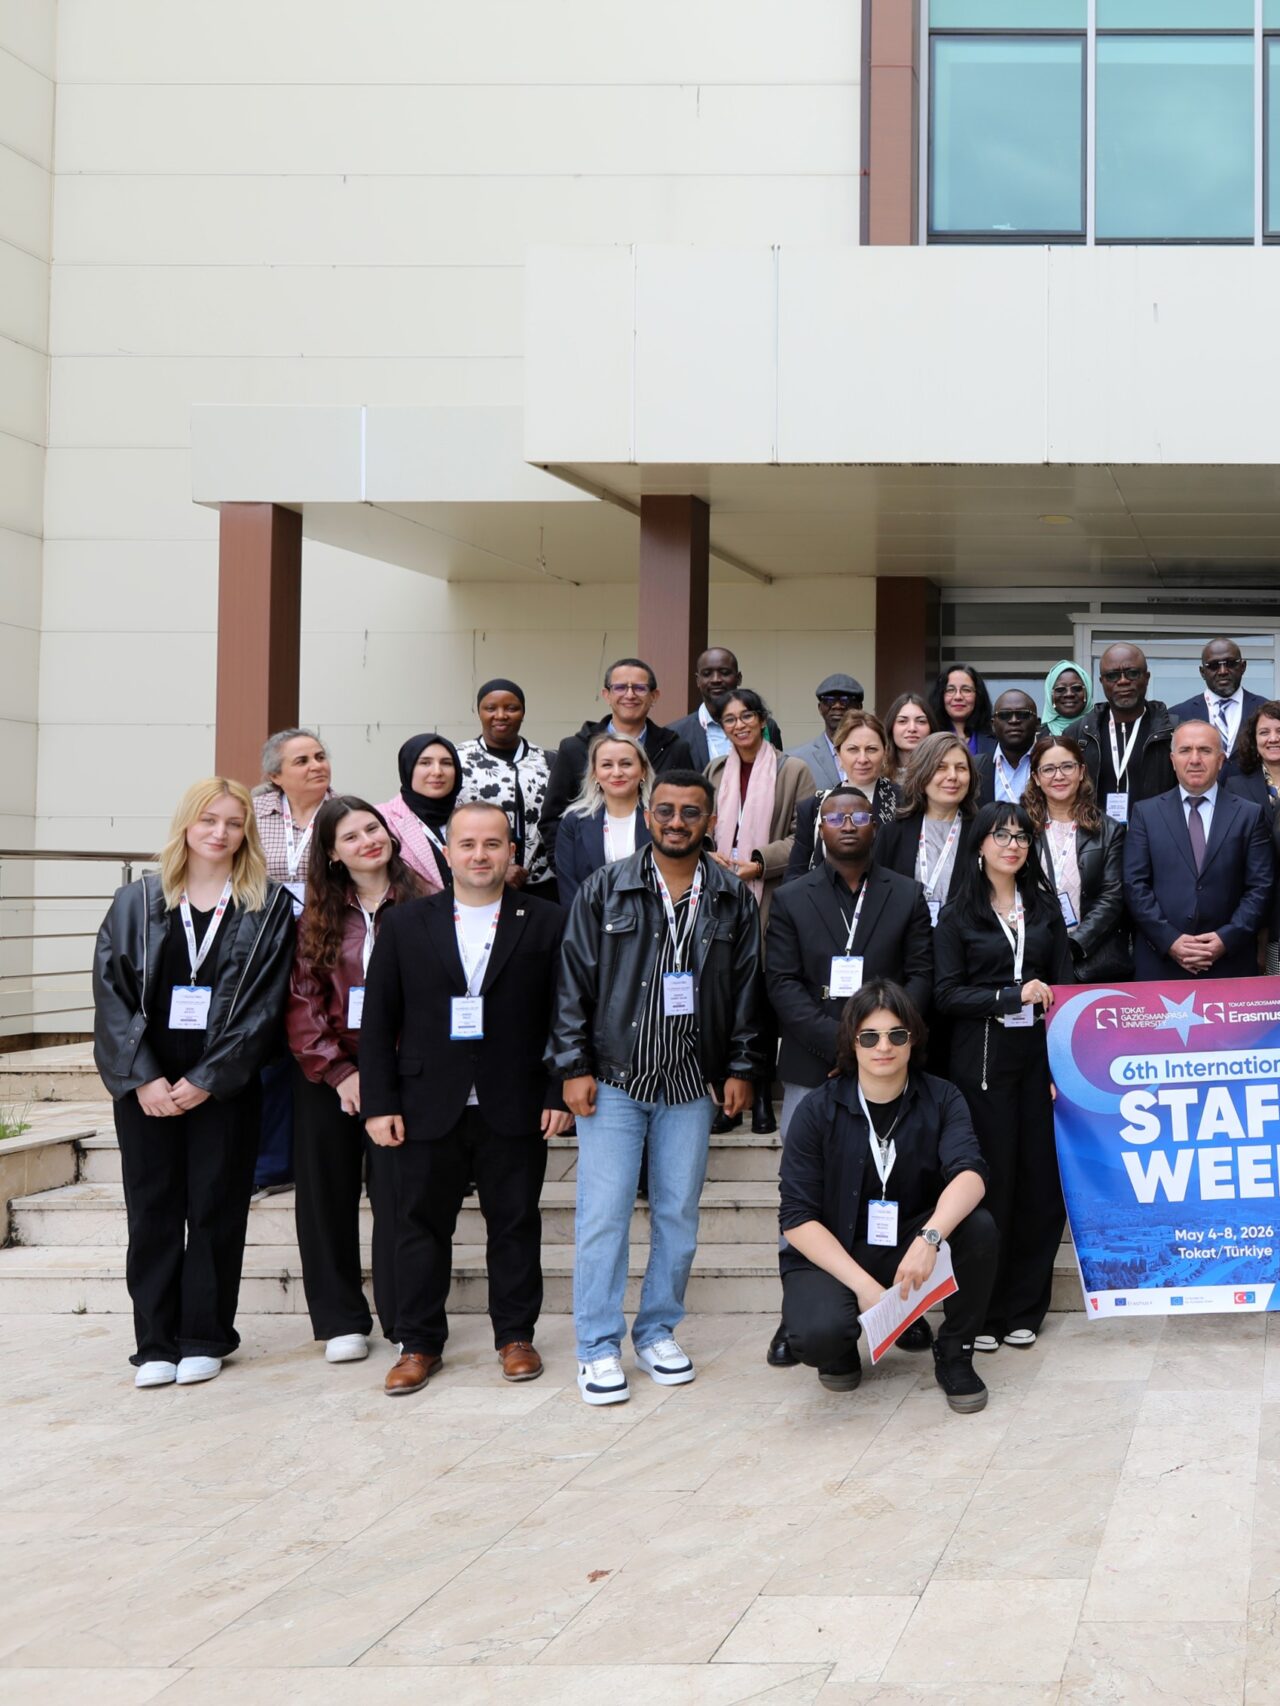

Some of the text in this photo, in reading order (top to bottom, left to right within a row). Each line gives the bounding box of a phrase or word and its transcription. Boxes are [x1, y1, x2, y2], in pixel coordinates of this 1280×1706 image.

[1120, 1006, 1146, 1015] TOKAT
[1121, 1019, 1167, 1029] UNIVERSITY
[1122, 1061, 1158, 1081] 6th
[1175, 1229, 1204, 1243] May
[1240, 1225, 1274, 1239] 2026
[1178, 1245, 1273, 1260] Tokat/Türkiye
